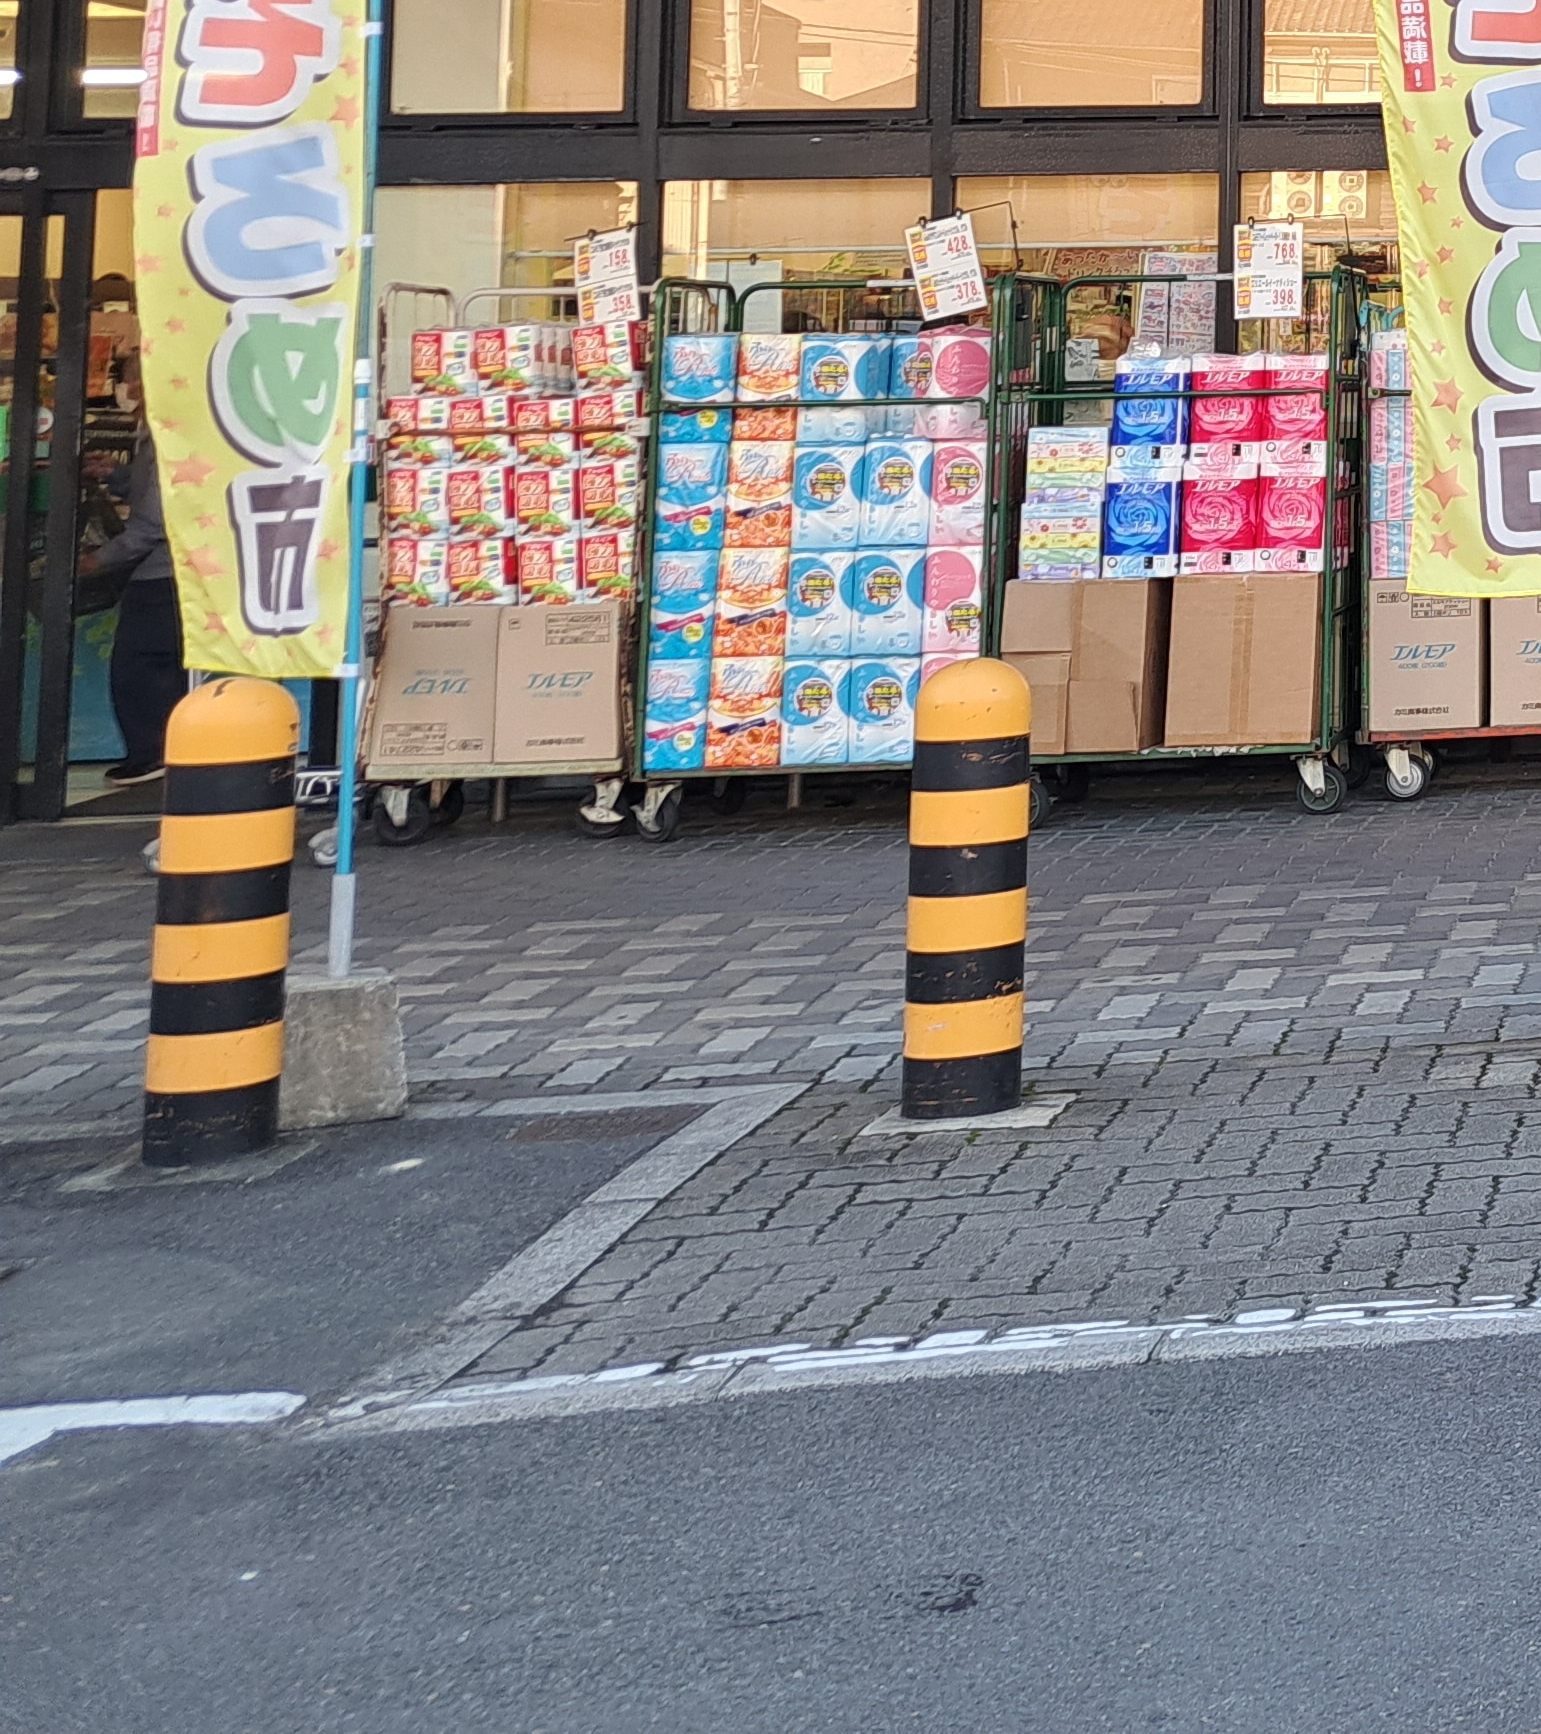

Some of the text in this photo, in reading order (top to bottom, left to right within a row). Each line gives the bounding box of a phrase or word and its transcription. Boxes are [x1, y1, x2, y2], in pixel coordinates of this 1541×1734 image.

[947, 234, 968, 253] 428
[1274, 243, 1296, 259] 768
[1272, 289, 1294, 305] 398
[1125, 373, 1173, 385] エルモア
[1201, 372, 1250, 383] エルモア
[1275, 370, 1325, 382] エルモア
[1191, 480, 1241, 492] エルモア
[1271, 477, 1321, 488] エルモア
[1117, 483, 1166, 495] エルモア
[1390, 643, 1456, 661] エルモア
[525, 671, 594, 689] エルモア
